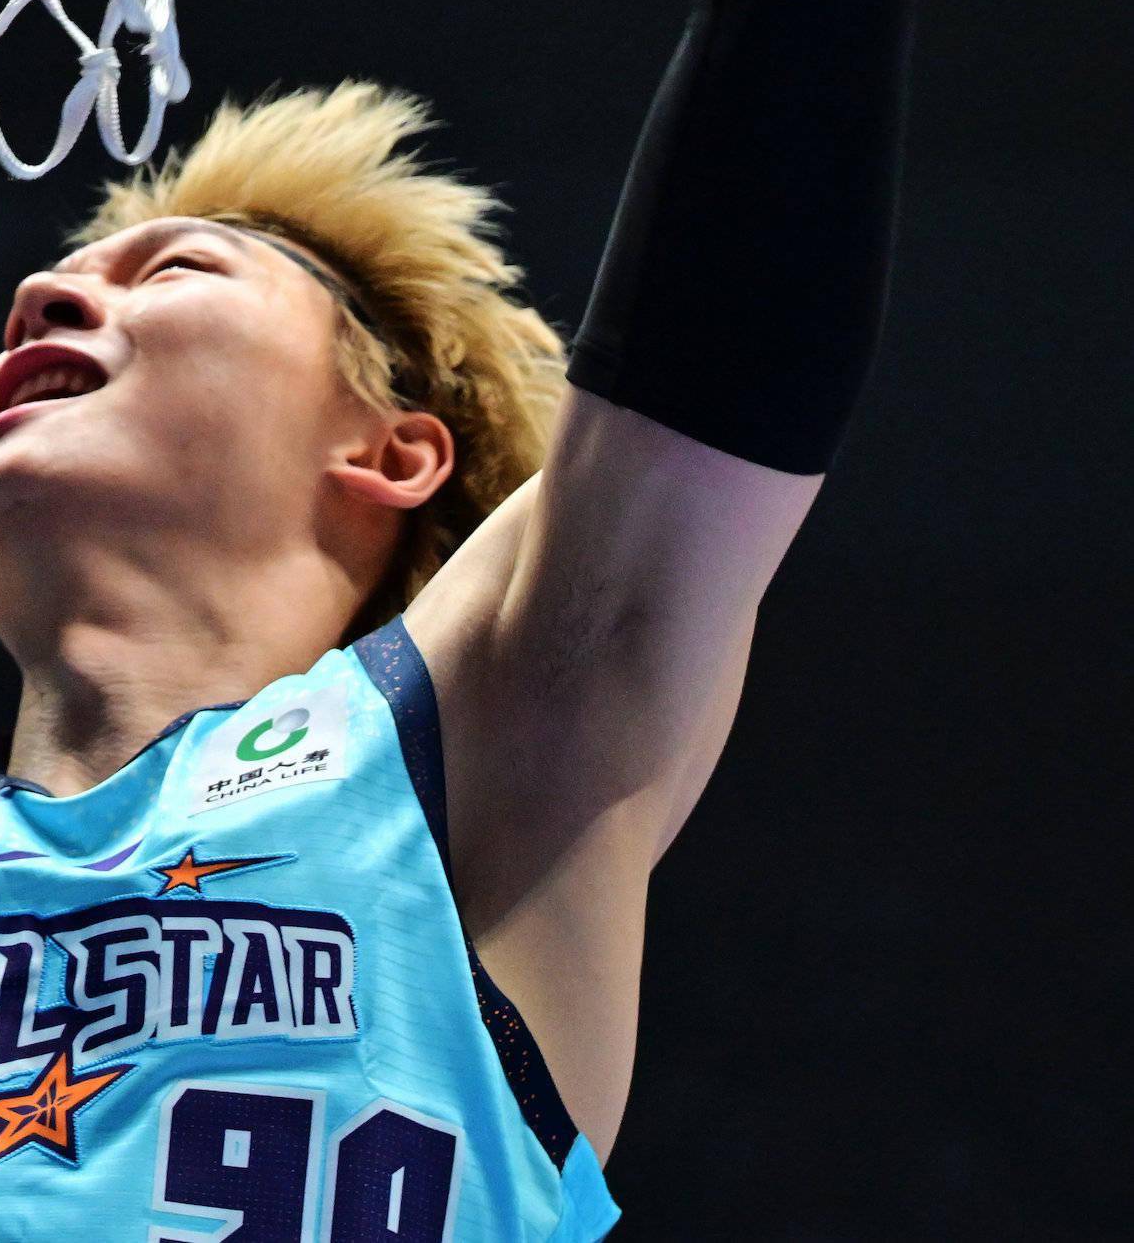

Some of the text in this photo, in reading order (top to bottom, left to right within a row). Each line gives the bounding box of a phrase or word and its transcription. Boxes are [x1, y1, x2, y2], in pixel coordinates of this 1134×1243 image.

[205, 763, 328, 803] CHINA LIFE
[208, 749, 330, 792] 中国人寿
